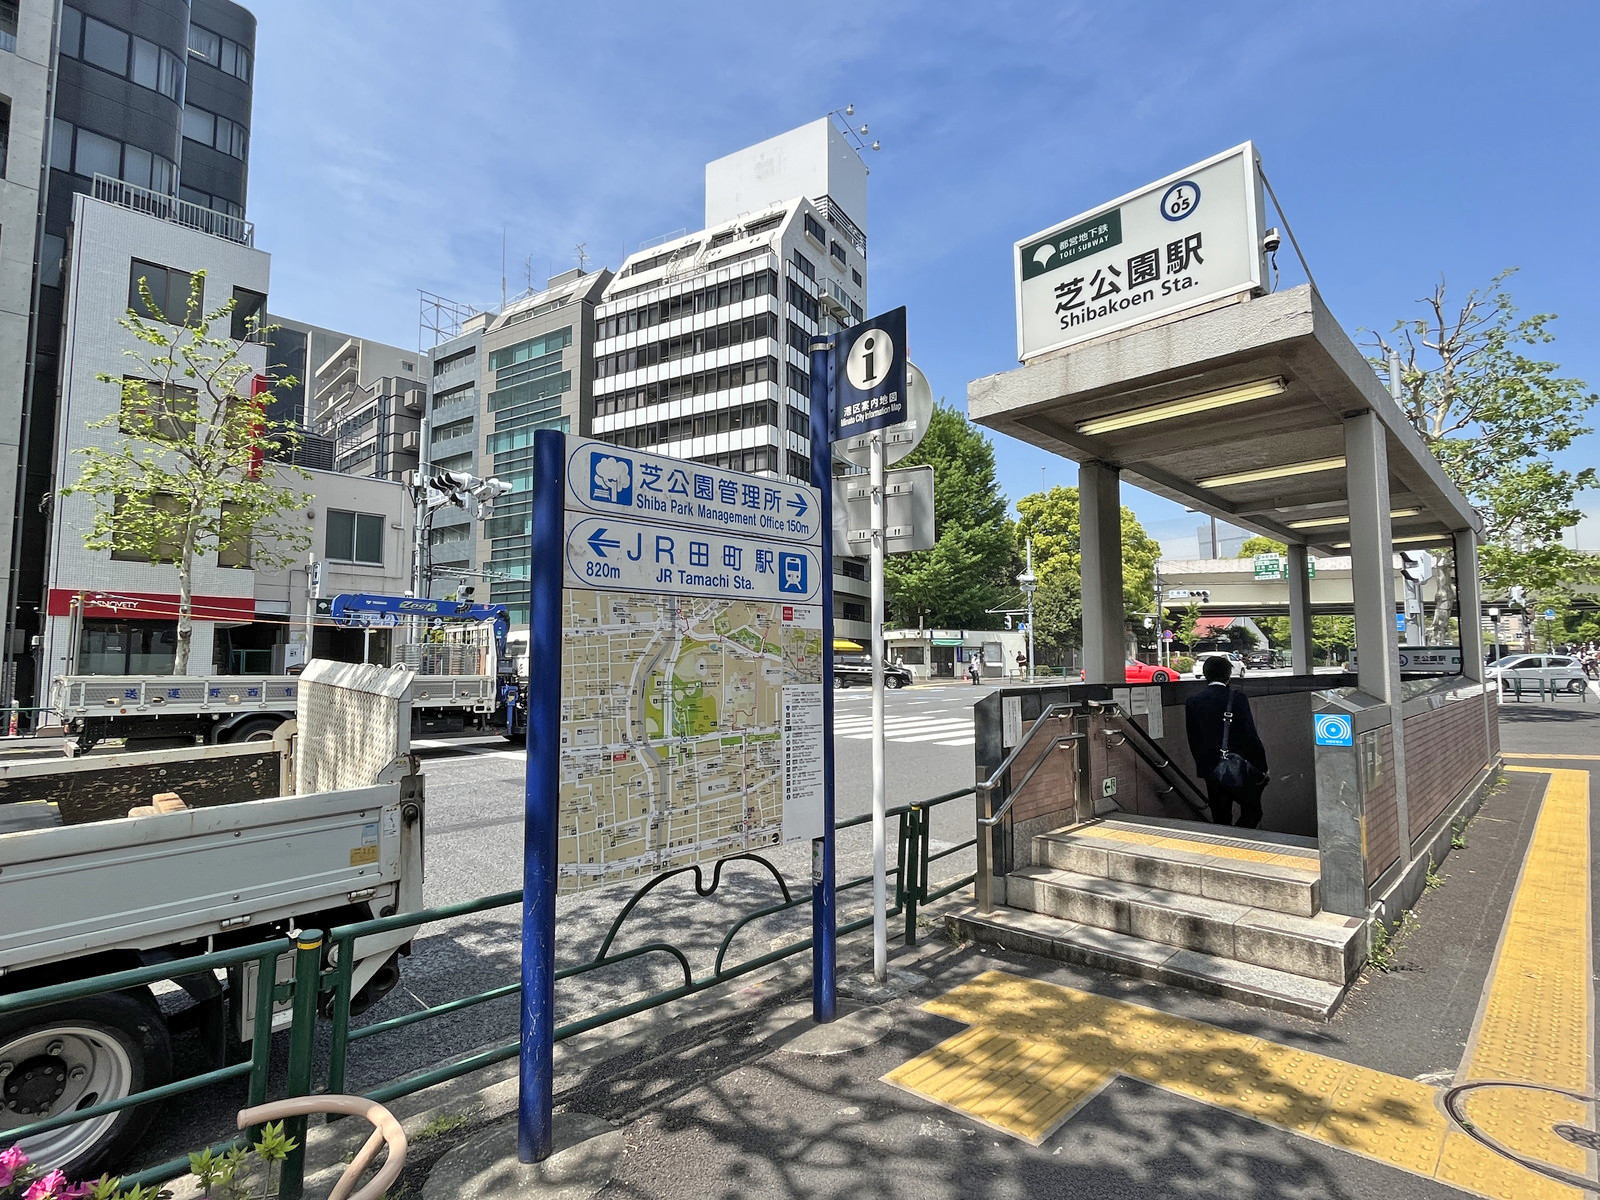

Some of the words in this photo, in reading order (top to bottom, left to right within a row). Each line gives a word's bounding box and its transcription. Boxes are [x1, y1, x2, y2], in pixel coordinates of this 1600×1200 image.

[1170, 198, 1190, 214] 05
[1059, 224, 1109, 250] 都営地下鉄
[1060, 248, 1077, 260] TOEI
[1078, 234, 1109, 254] SUBWAY
[1054, 232, 1205, 315] 芝公園駅
[1060, 285, 1154, 330] Shibakoen
[1161, 274, 1199, 297] Sta.
[840, 416, 855, 427] Minato
[855, 413, 865, 423] City
[864, 405, 891, 420] Information
[891, 403, 902, 413] Map
[843, 391, 897, 417] 港区案内地図
[639, 462, 782, 514] 芝公園管理所
[636, 493, 667, 513] Shiba
[670, 498, 694, 516] Park
[697, 505, 757, 527] Management
[760, 513, 785, 531] Office
[786, 519, 809, 535] 150m
[586, 560, 621, 580] 820m
[656, 568, 672, 584] JR
[678, 569, 730, 590] Tamachi
[733, 575, 755, 591] Sta.
